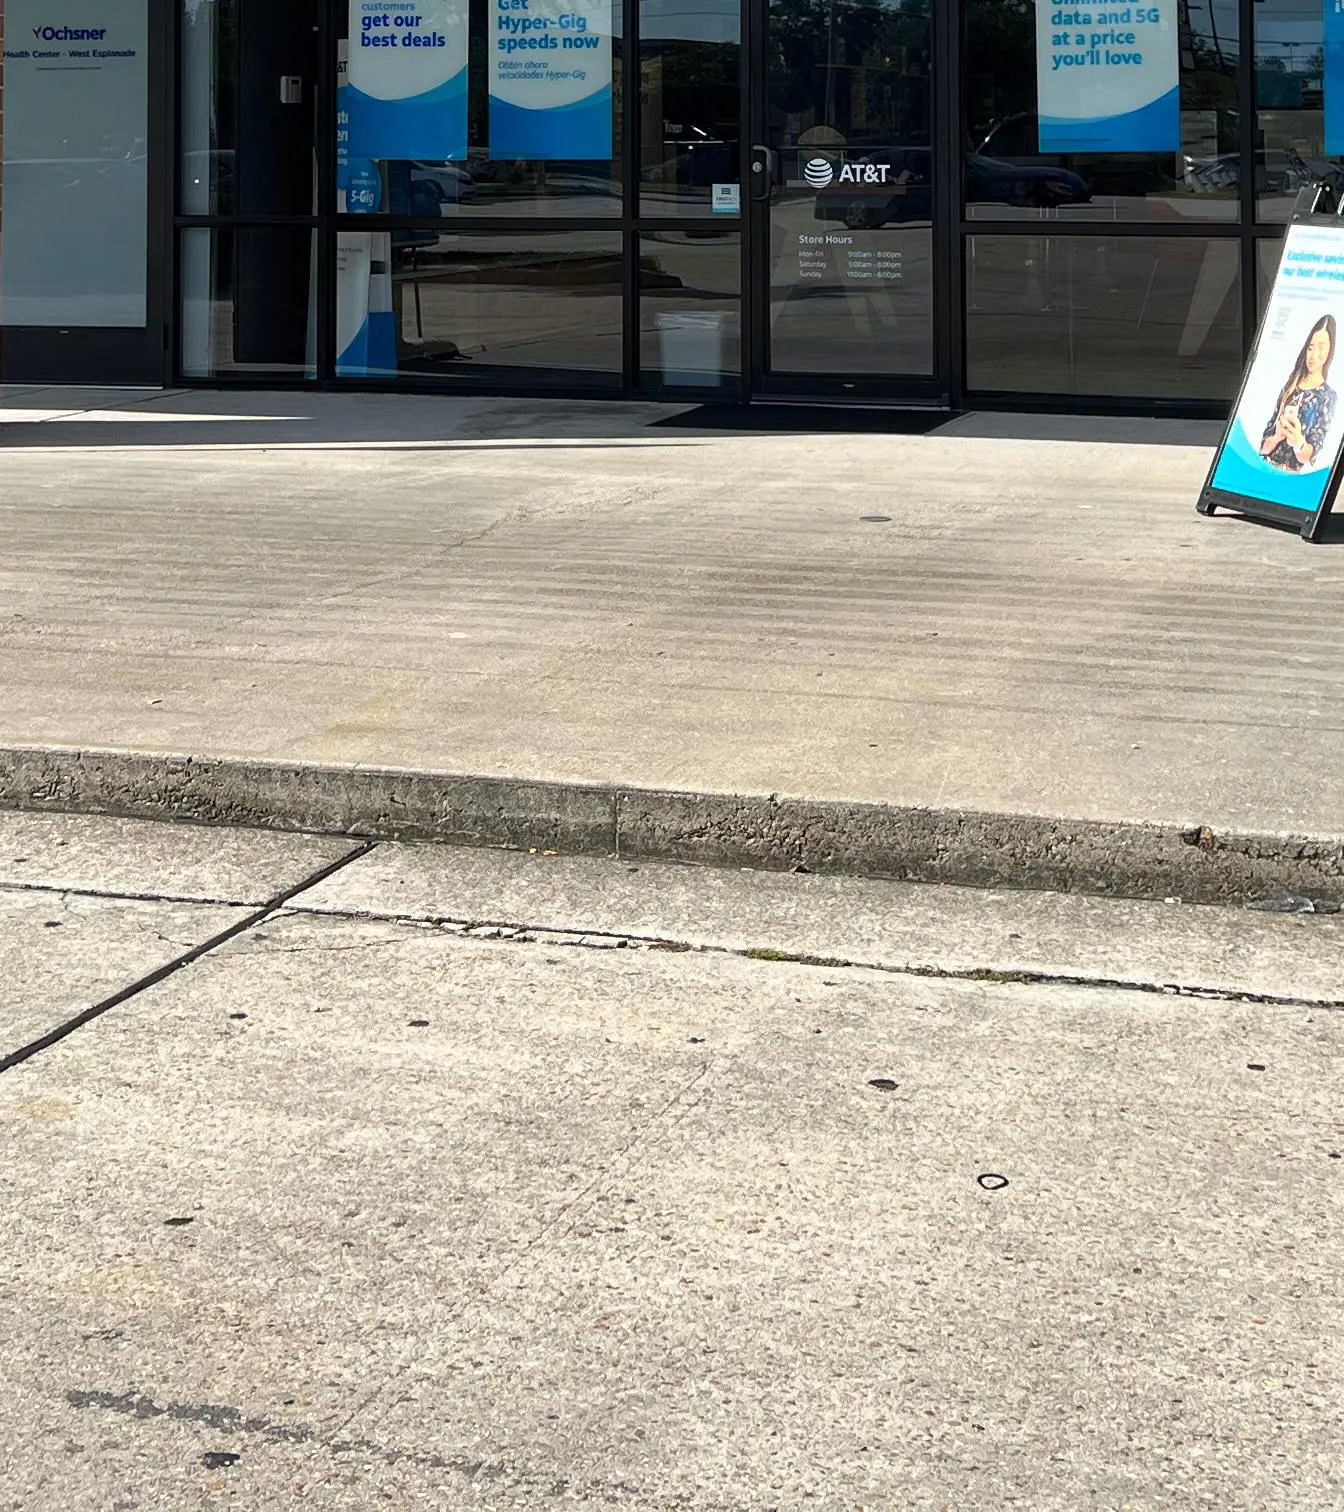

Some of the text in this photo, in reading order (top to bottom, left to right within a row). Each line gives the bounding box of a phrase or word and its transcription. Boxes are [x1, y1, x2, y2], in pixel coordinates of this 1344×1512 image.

[361, 2, 416, 11] customers
[361, 14, 423, 31] get our
[498, 13, 587, 33] Hyper-Gig
[1051, 8, 1160, 25] data and 5G
[42, 26, 107, 41] Ochsner
[361, 32, 446, 47] best deals
[1052, 29, 1136, 49] at a price
[497, 34, 600, 54] speeds now
[1051, 50, 1143, 71] you'll love
[839, 164, 890, 183] AT&T
[351, 189, 374, 207] 5-Gig
[799, 234, 852, 244] Store Hours
